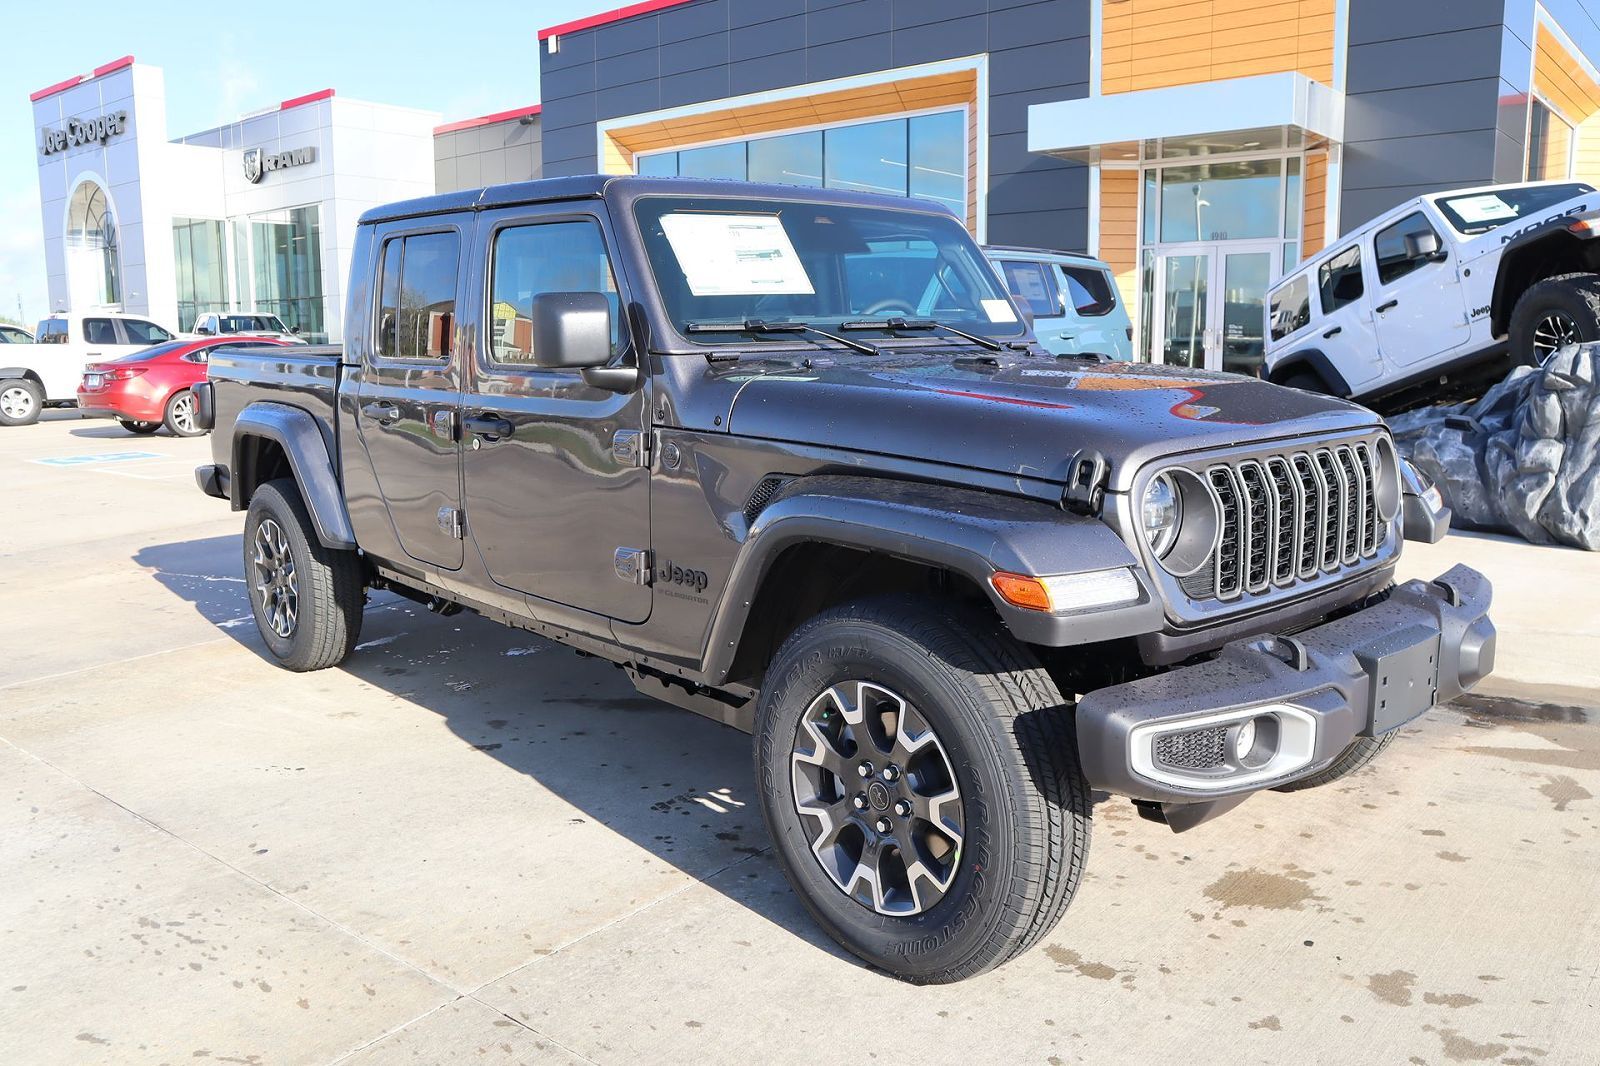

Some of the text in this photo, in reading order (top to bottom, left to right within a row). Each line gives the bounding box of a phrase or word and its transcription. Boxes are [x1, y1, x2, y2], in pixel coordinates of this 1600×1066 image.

[40, 110, 127, 156] Joe Cooper
[263, 146, 316, 172] RAM
[1470, 304, 1491, 318] Jeep
[659, 560, 708, 593] Jeep
